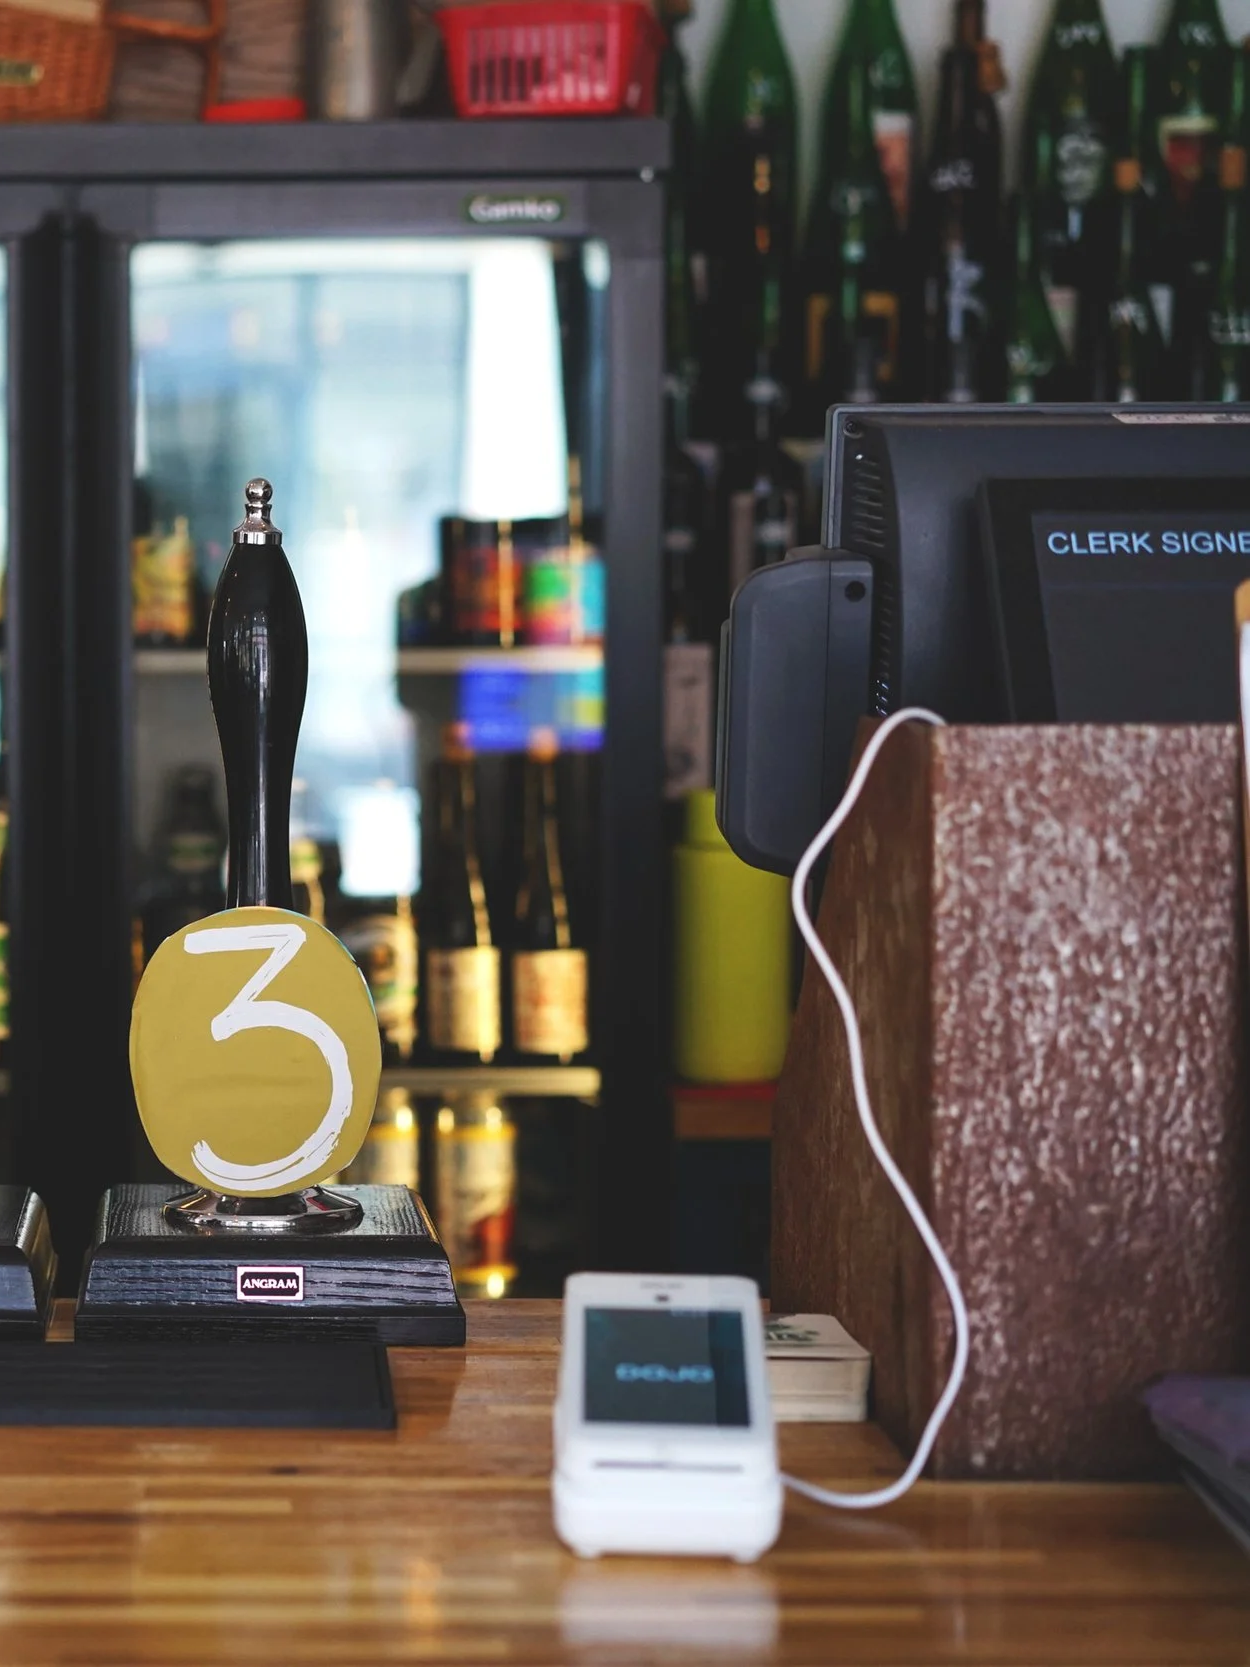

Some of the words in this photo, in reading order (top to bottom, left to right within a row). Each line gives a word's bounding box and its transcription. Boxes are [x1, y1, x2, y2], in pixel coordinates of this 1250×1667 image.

[1047, 531, 1154, 554] CLERK
[183, 923, 353, 1191] 3
[242, 1278, 298, 1289] ANGRAM
